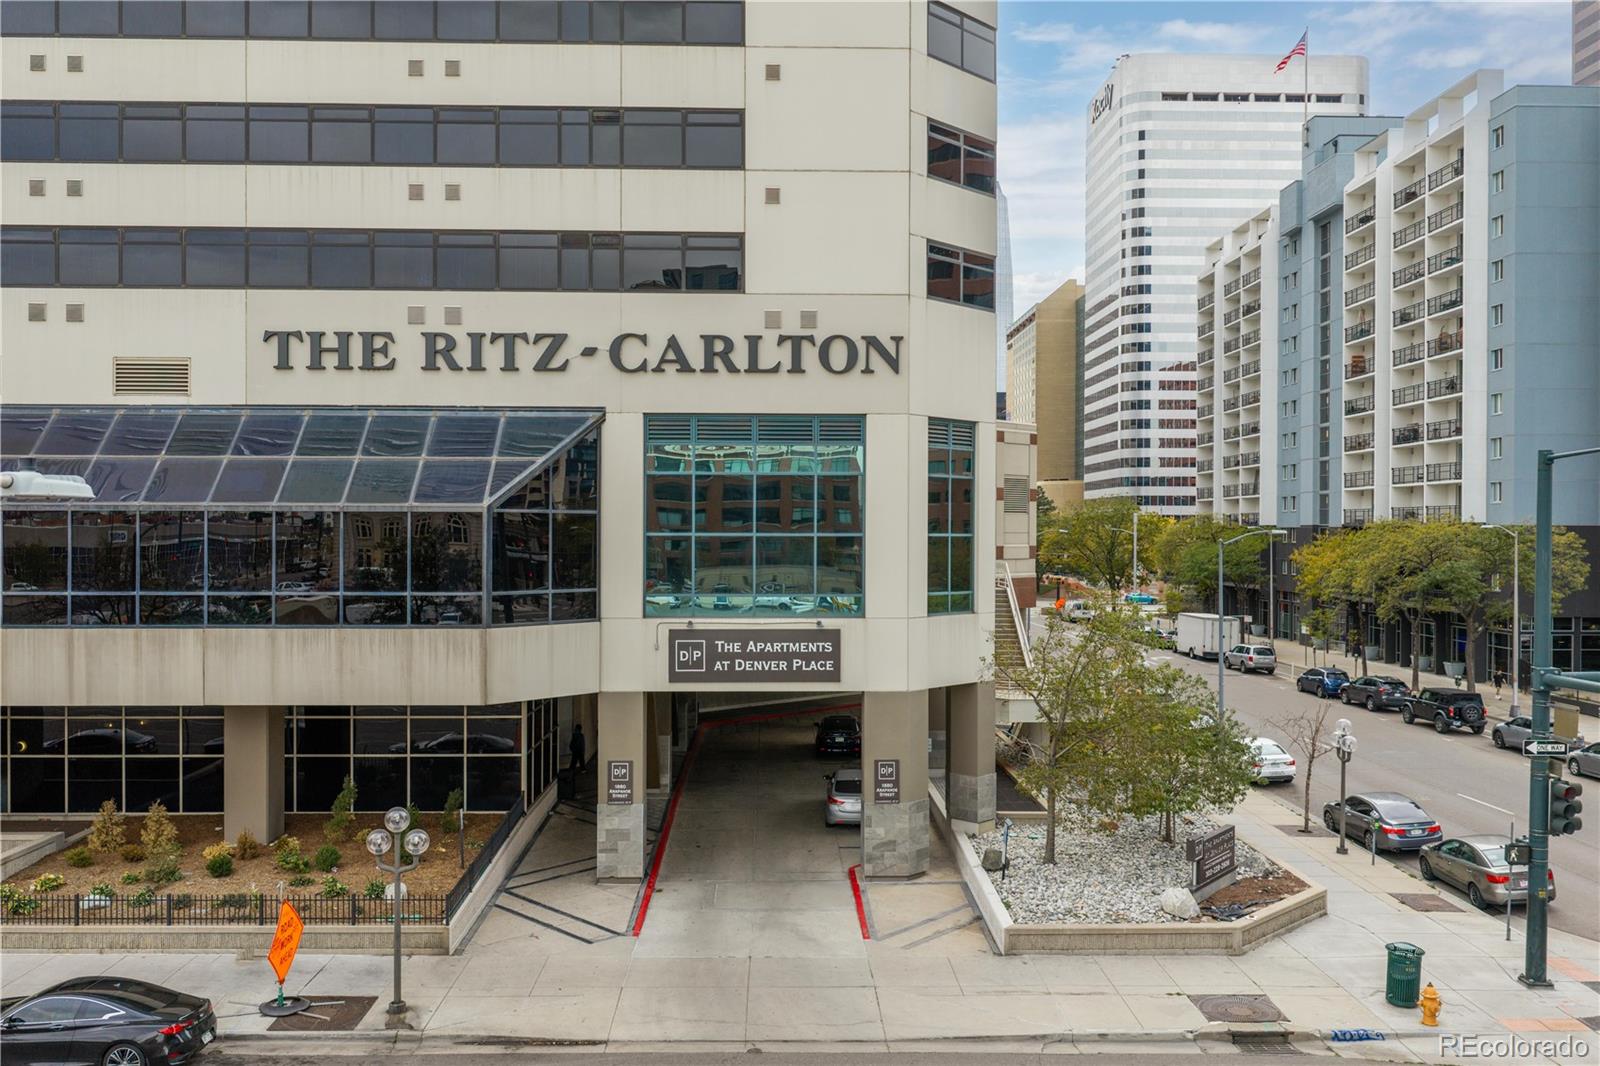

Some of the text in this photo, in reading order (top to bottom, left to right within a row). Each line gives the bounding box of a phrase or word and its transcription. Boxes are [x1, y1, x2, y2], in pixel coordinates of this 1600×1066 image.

[263, 330, 397, 371] THE
[715, 640, 832, 653] THE APARTMENTS
[714, 659, 834, 671] AT DENVER PLACE
